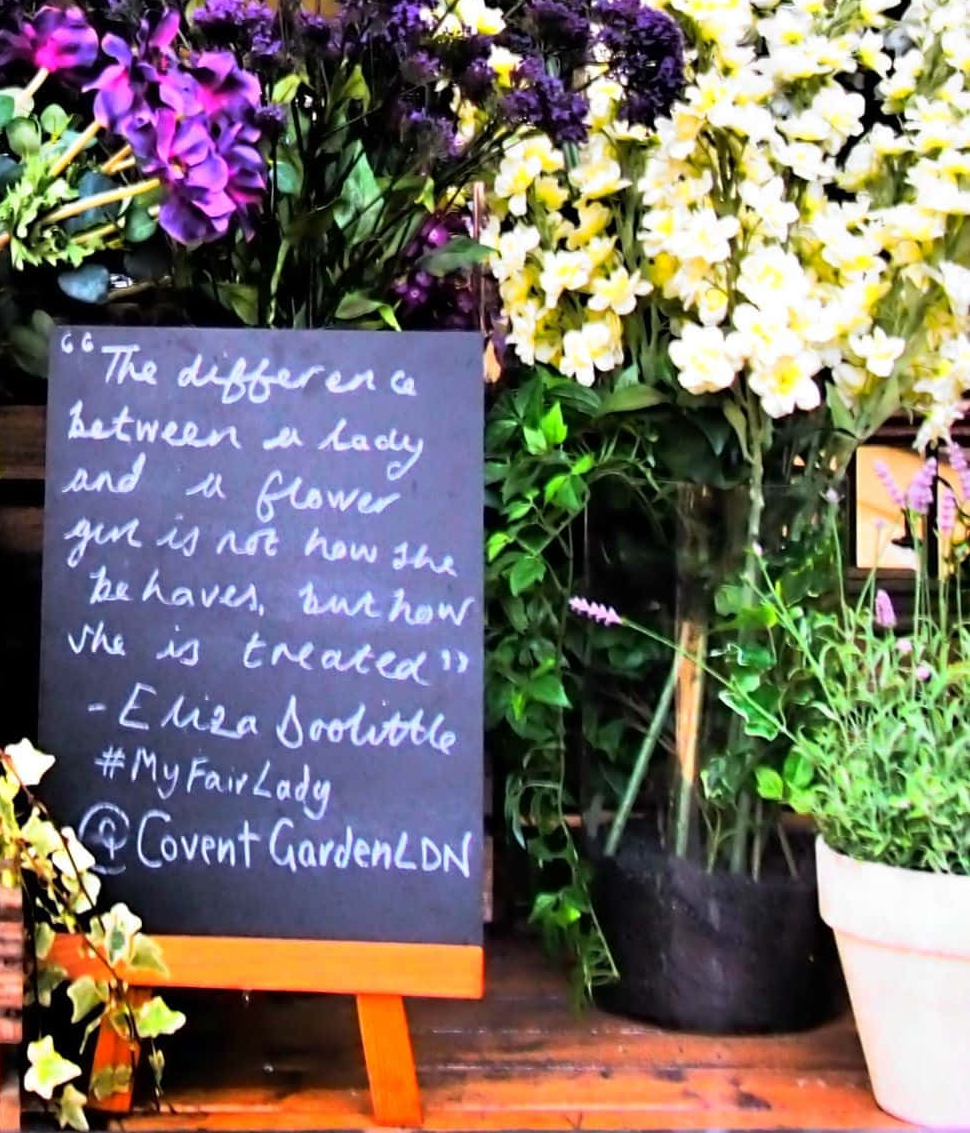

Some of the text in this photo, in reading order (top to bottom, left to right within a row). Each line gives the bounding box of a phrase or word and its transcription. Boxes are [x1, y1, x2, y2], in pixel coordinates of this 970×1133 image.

[67, 400, 424, 482] between a lady
[61, 452, 401, 523] and a flower
[157, 513, 199, 557] is
[216, 529, 281, 556] not
[305, 528, 377, 562] how
[392, 544, 458, 578] she
[300, 582, 383, 617] but
[388, 590, 475, 627] how
[67, 619, 126, 657] she
[155, 624, 199, 667] is
[118, 682, 258, 739] Eliza
[276, 694, 457, 756] Doolittle
[95, 745, 331, 821] #MyFairLady
